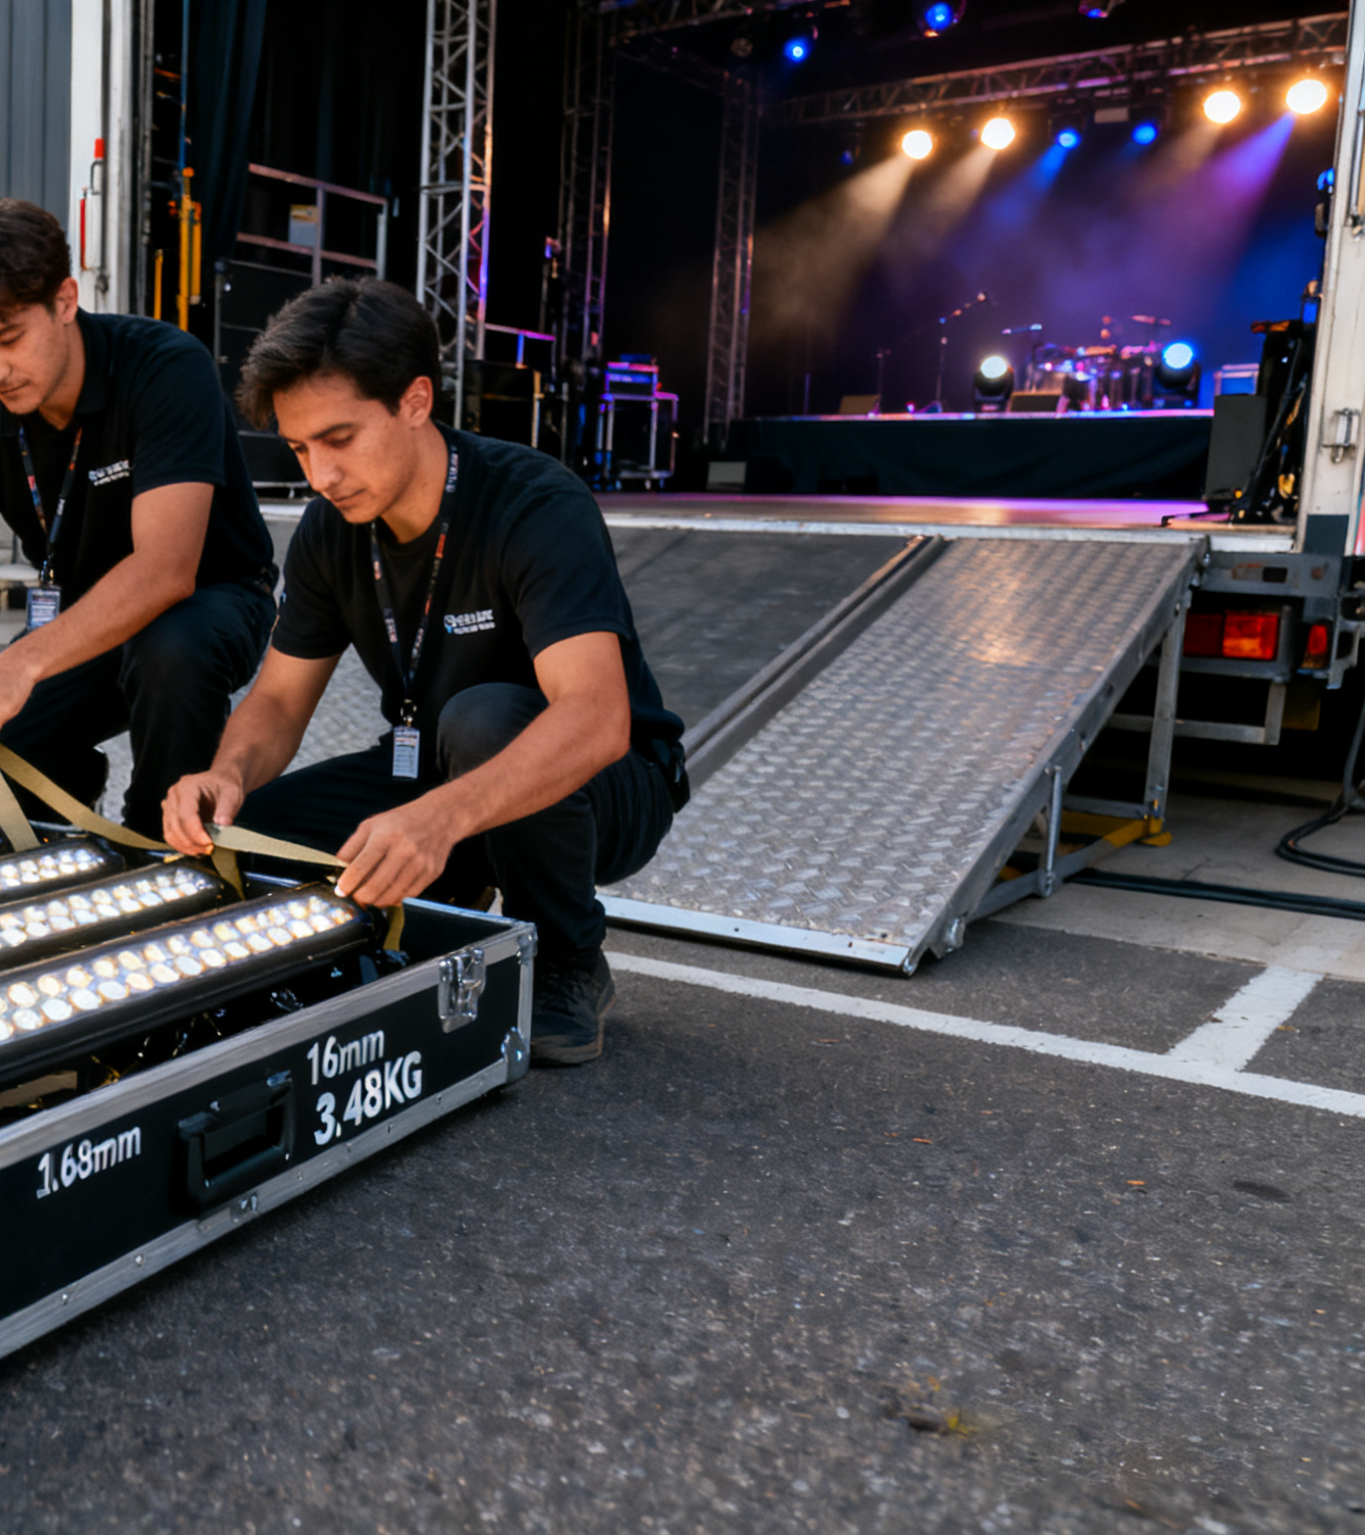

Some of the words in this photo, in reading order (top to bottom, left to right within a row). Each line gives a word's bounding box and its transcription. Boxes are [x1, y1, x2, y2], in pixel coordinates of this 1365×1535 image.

[306, 1029, 385, 1085] 16mm
[314, 1051, 422, 1145] 3.48KG
[36, 1126, 141, 1199] 1.68mm
